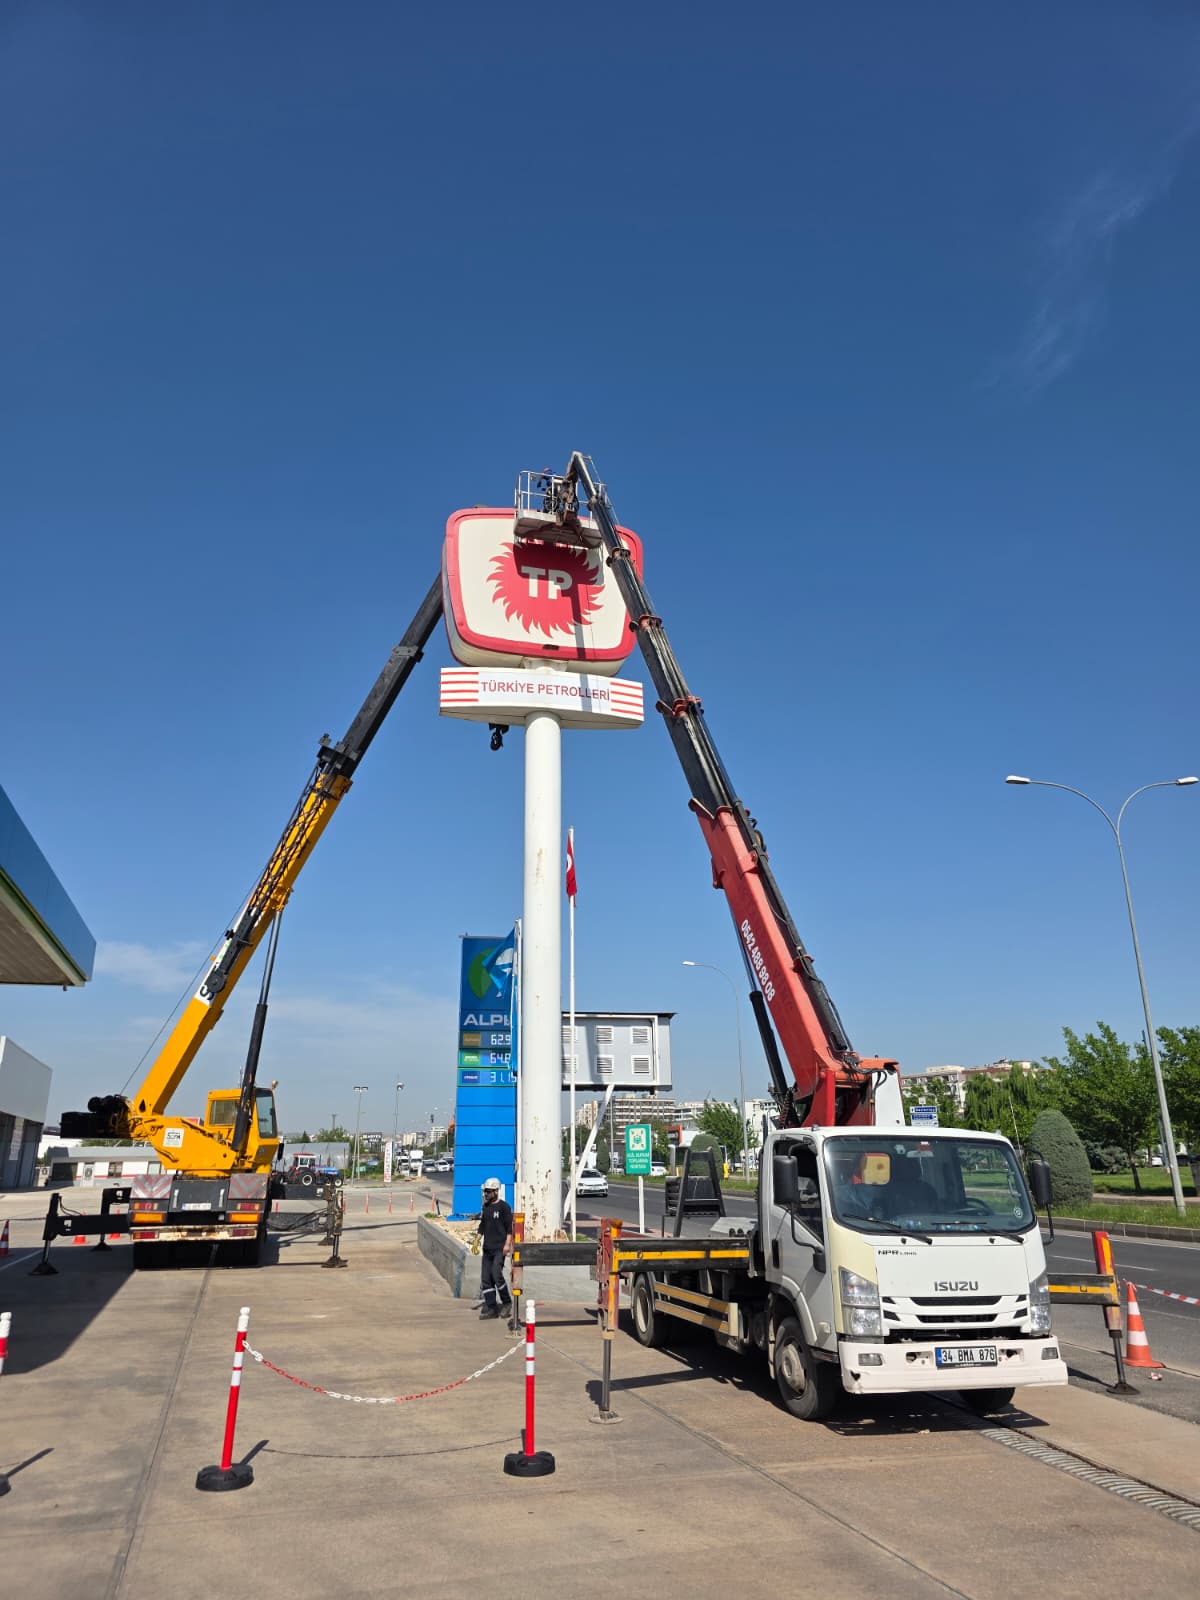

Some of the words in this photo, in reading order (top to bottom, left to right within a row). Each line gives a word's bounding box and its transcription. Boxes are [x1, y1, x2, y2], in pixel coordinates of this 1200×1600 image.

[521, 566, 573, 600] TP
[481, 680, 535, 694] TÜRKİYE
[537, 684, 610, 701] PETROLLERİ
[741, 919, 756, 950] 0542
[934, 1281, 979, 1292] ISUZU
[942, 1350, 953, 1362] 34
[958, 1349, 975, 1361] BMA
[979, 1348, 995, 1361] 876
